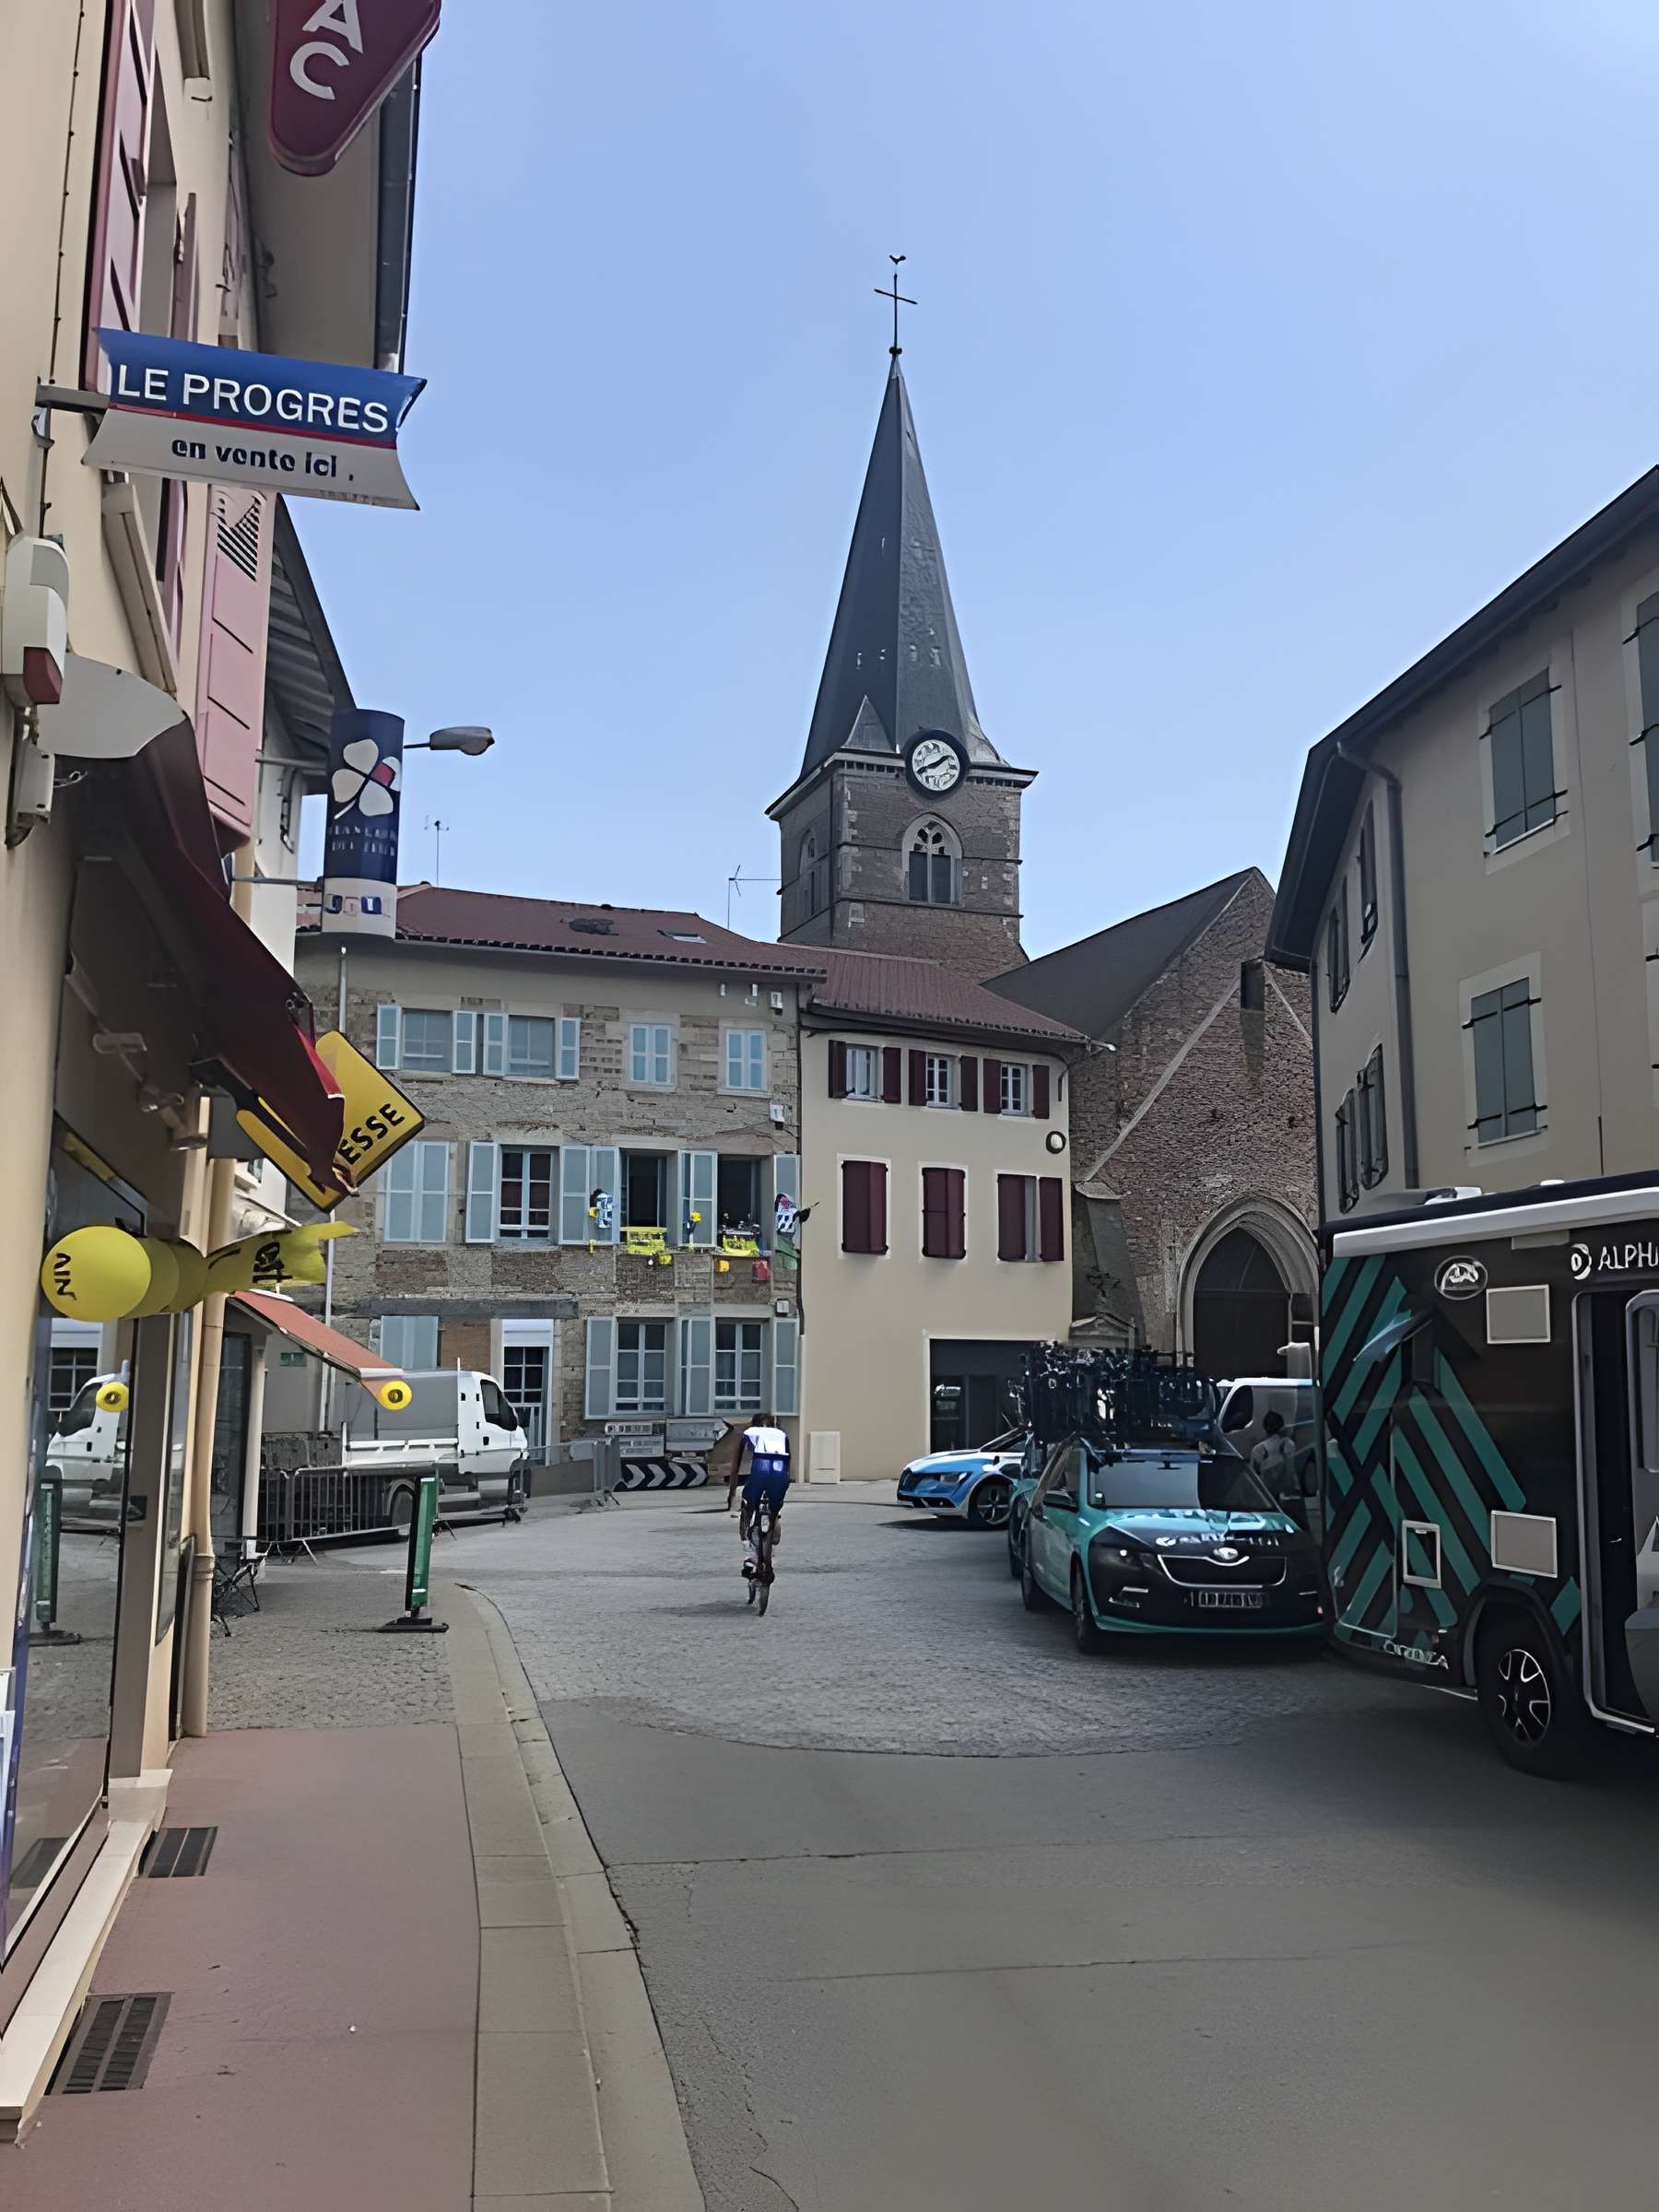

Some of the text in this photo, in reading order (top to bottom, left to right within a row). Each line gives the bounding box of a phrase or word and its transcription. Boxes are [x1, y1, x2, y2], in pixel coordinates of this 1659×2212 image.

[118, 364, 388, 433] LE PROGRES
[171, 439, 206, 460] en
[216, 445, 296, 472] vente
[336, 1103, 406, 1165] ESSE
